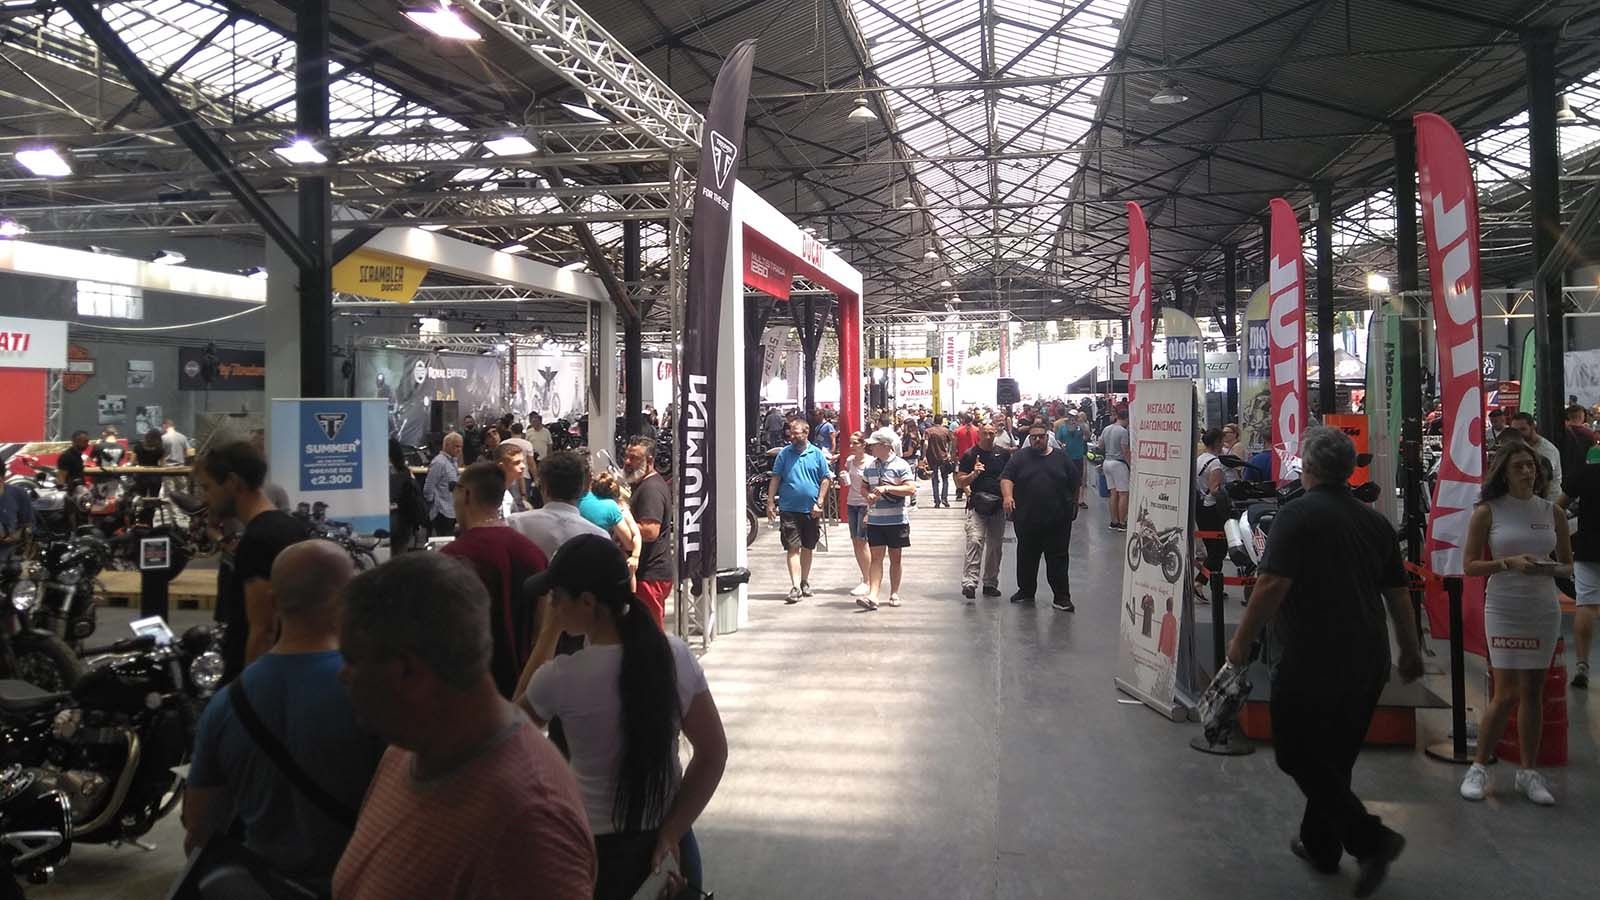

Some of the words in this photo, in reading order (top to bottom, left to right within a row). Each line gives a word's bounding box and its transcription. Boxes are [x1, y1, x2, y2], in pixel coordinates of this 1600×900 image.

[702, 187, 714, 200] FOR
[359, 264, 404, 283] SCRAMBLER
[1431, 192, 1484, 577] MOTUL
[1139, 441, 1167, 459] MOTUL
[683, 374, 709, 562] TRIUMPH
[311, 474, 353, 485] €2.300
[1493, 638, 1538, 649] MOTUL
